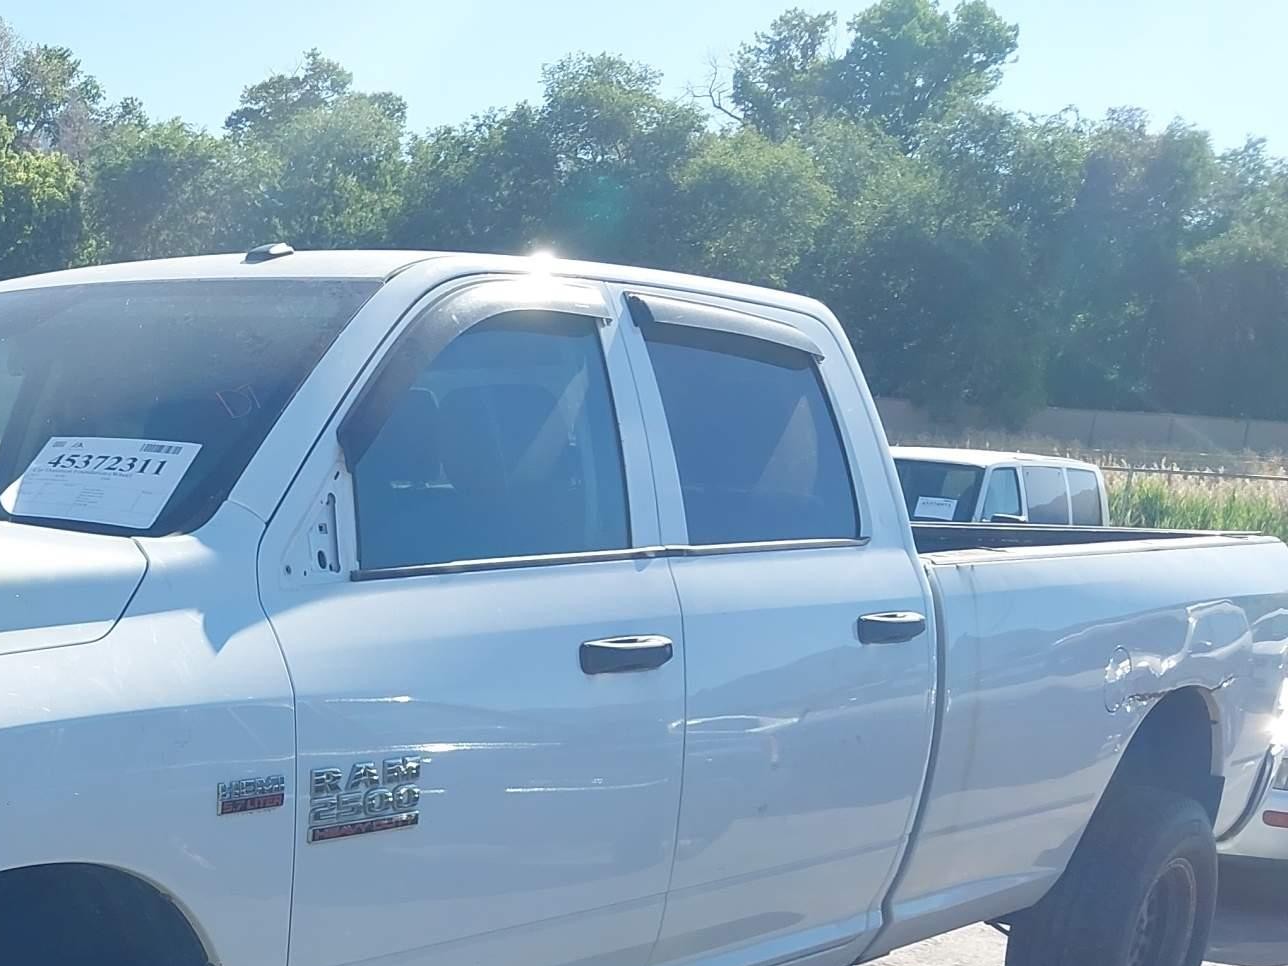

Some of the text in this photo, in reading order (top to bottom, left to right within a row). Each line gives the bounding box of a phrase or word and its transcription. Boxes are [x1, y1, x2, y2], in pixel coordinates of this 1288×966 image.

[48, 453, 168, 476] 45372311
[309, 755, 421, 794] RAM
[309, 783, 420, 824] 2500
[314, 820, 370, 840] HEAVY
